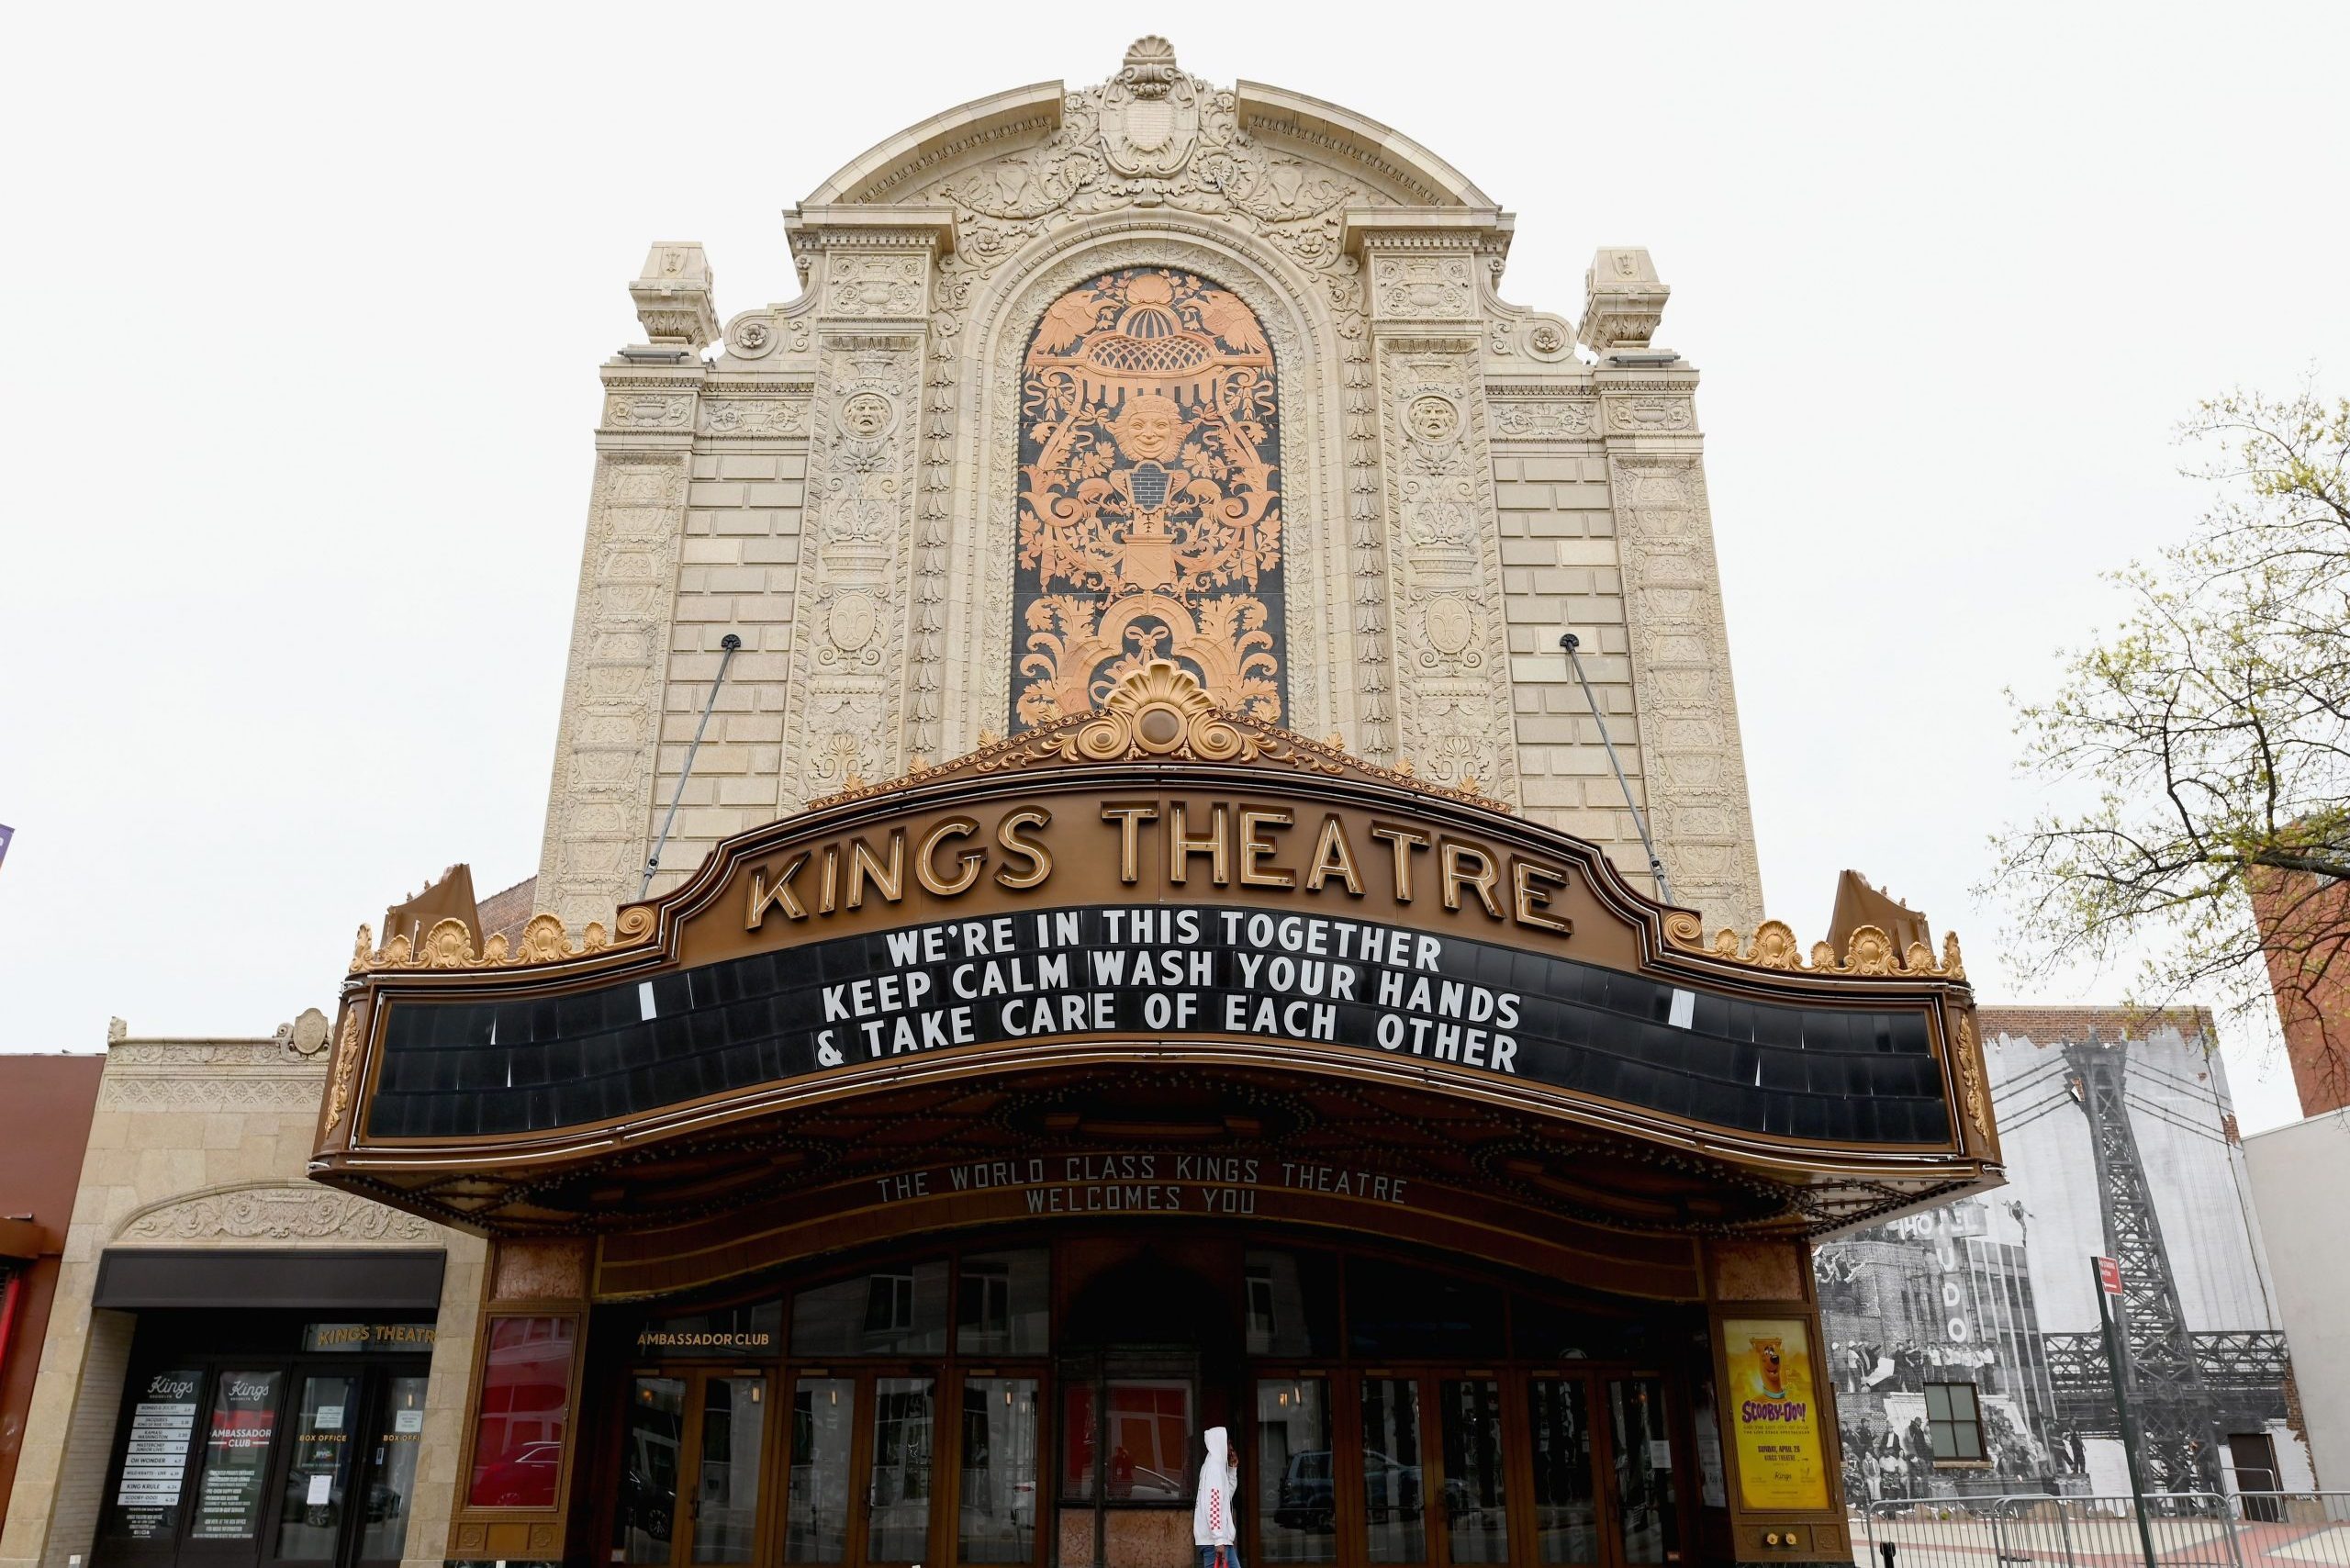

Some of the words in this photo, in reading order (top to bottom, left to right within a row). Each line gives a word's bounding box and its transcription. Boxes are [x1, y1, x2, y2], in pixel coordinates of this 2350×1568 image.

[744, 805, 1053, 931] KINGS
[1101, 801, 1574, 935] THEATRE
[887, 918, 1014, 967] WE'RE
[1037, 912, 1079, 948] IN
[1102, 909, 1199, 944] THIS
[1221, 911, 1441, 972] TOGETHER
[822, 971, 931, 1022] KEEP
[952, 955, 1068, 999] CALM
[1094, 951, 1213, 986] WASH
[1237, 953, 1355, 1001] YOUR
[1379, 970, 1520, 1029] HANDS
[817, 1030, 844, 1067] &
[861, 1006, 975, 1058] TAKE
[1002, 993, 1115, 1036] CARE
[1145, 992, 1197, 1030] OF
[1225, 994, 1337, 1041] EACH
[1377, 1014, 1517, 1073] OTHER
[877, 1172, 929, 1203] THE
[950, 1159, 1043, 1190] WORLD
[1067, 1155, 1155, 1182] CLASS
[1177, 1156, 1259, 1183] KINGS
[1282, 1163, 1407, 1204] THEATRE
[1026, 1185, 1181, 1214] WELCOMES
[1203, 1188, 1255, 1214] YOU
[318, 1327, 370, 1346] KINGS
[637, 1334, 732, 1345] AMBASSADOR
[735, 1334, 769, 1345] CLUB
[147, 1376, 194, 1398] Kings
[229, 1381, 269, 1401] Kings
[1741, 1400, 1807, 1423] SCOOBY-DOO!
[211, 1428, 272, 1438] AMBASSADOR
[228, 1439, 251, 1447] CLUB
[318, 1434, 347, 1442] OFFICE
